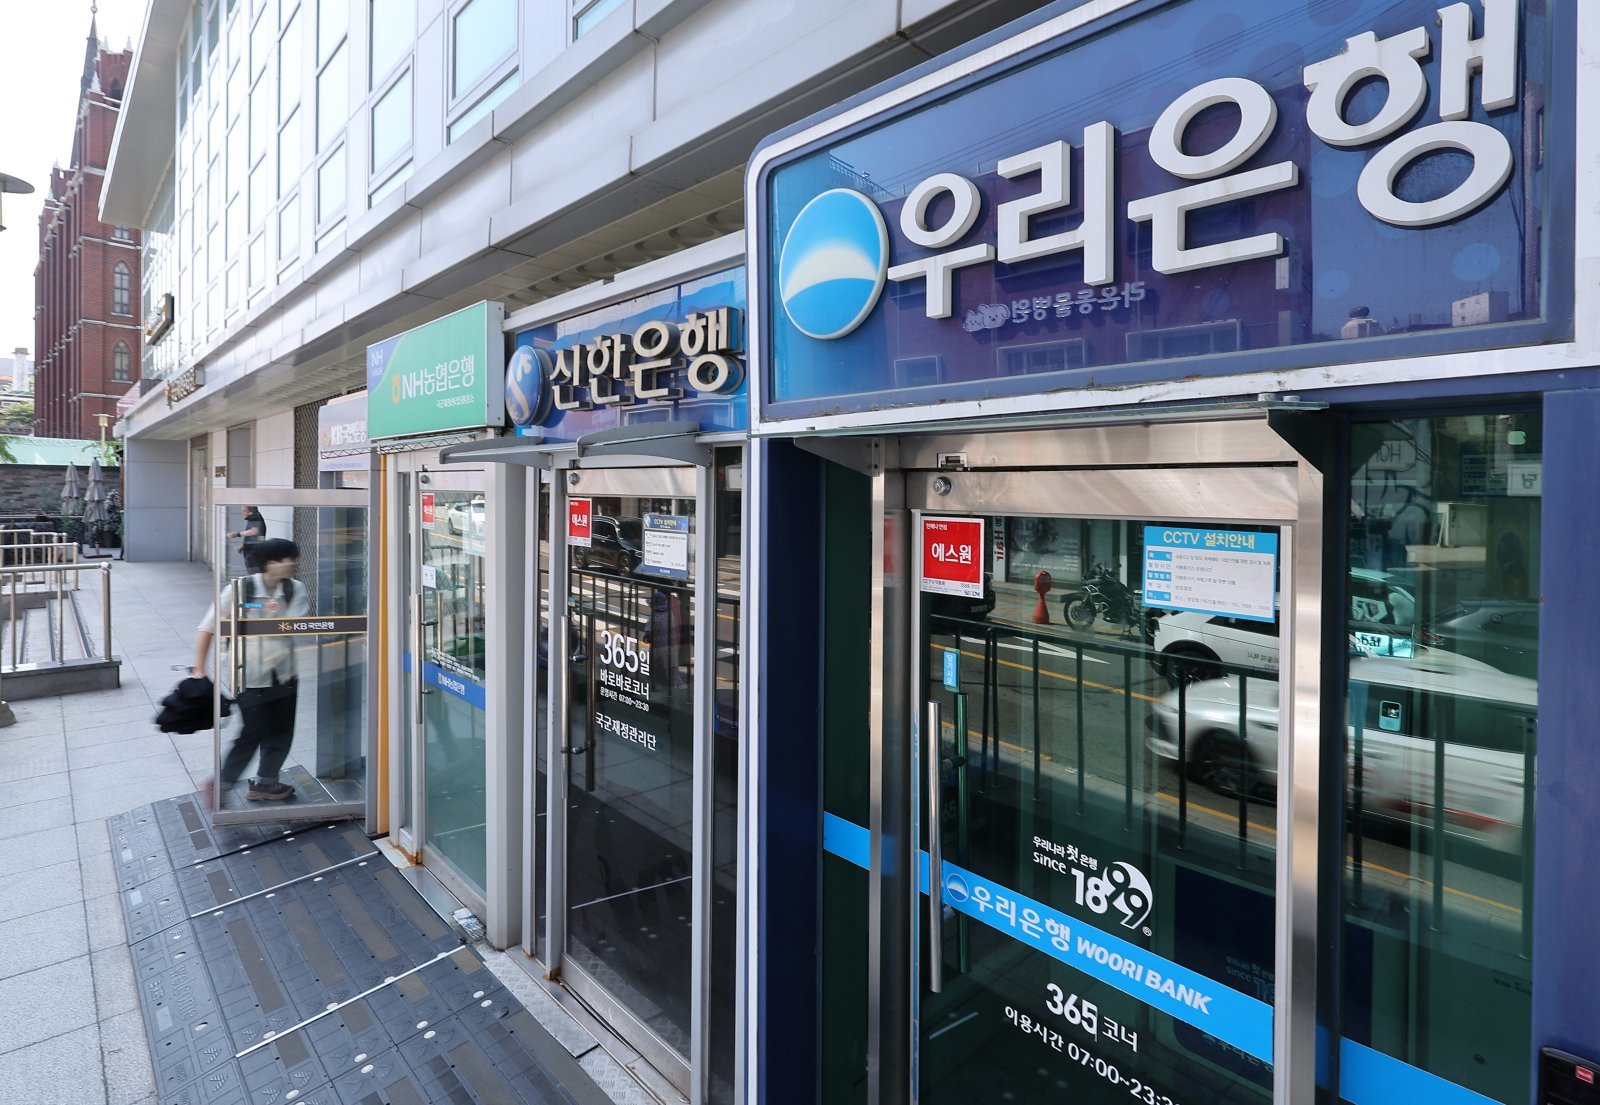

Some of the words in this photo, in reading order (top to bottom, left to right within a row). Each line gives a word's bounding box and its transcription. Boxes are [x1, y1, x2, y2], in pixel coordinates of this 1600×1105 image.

[887, 0, 1519, 319] 우리은행
[402, 354, 475, 400] NH농협은행
[550, 306, 738, 411] 신한은행
[931, 542, 972, 565] 에스원
[1163, 530, 1200, 545] CCTV
[1204, 532, 1255, 550] 설치안내
[293, 621, 335, 631] KB국민은행
[600, 630, 650, 676] 365일
[600, 668, 650, 701] 바로바로코너
[600, 686, 618, 701] 운영시간
[596, 711, 657, 752] 국군재정관리단
[1032, 835, 1065, 858] 우리나라
[1066, 843, 1079, 863] 첫
[1079, 853, 1098, 871] 은행
[1033, 851, 1067, 875] since
[971, 886, 1071, 952] 우리은행
[1077, 936, 1142, 982] WOORI
[1144, 969, 1213, 1016] BANK
[1004, 1005, 1064, 1053] 이용시간
[1046, 982, 1098, 1037] 365
[1102, 1015, 1138, 1053] 코너
